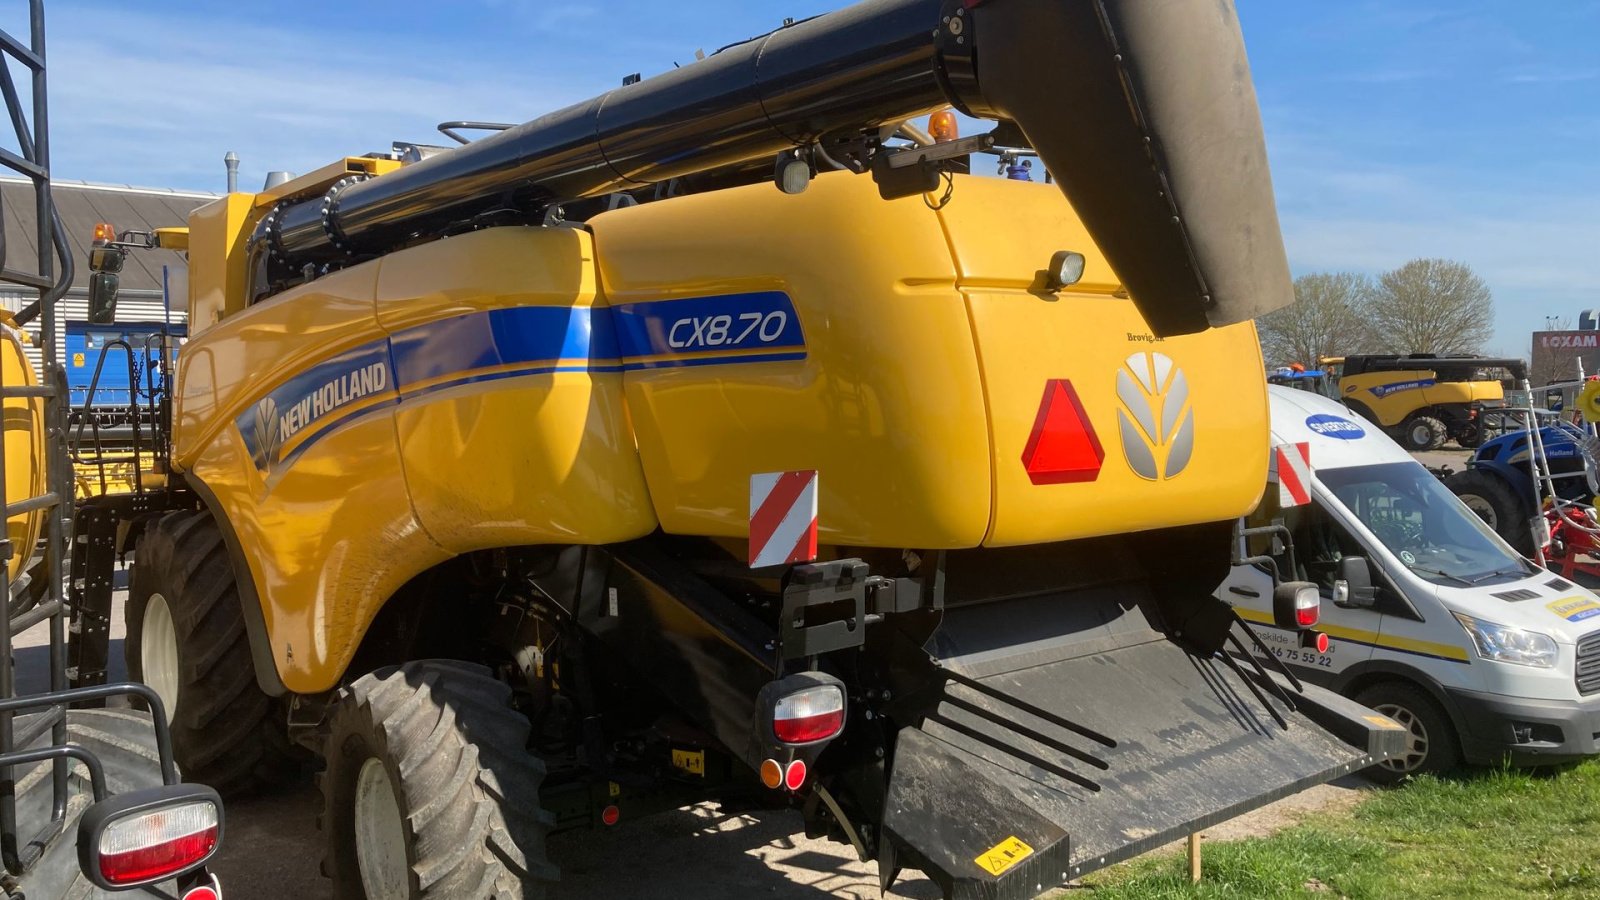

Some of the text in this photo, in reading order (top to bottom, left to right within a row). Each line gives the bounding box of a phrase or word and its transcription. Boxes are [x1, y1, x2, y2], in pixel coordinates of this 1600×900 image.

[668, 310, 787, 348] CX8.70
[280, 362, 386, 442] NEW HOLLAND
[1253, 629, 1289, 644] oskilde
[1286, 649, 1299, 660] 75
[1302, 652, 1315, 663] 55
[1318, 655, 1332, 667] 22
